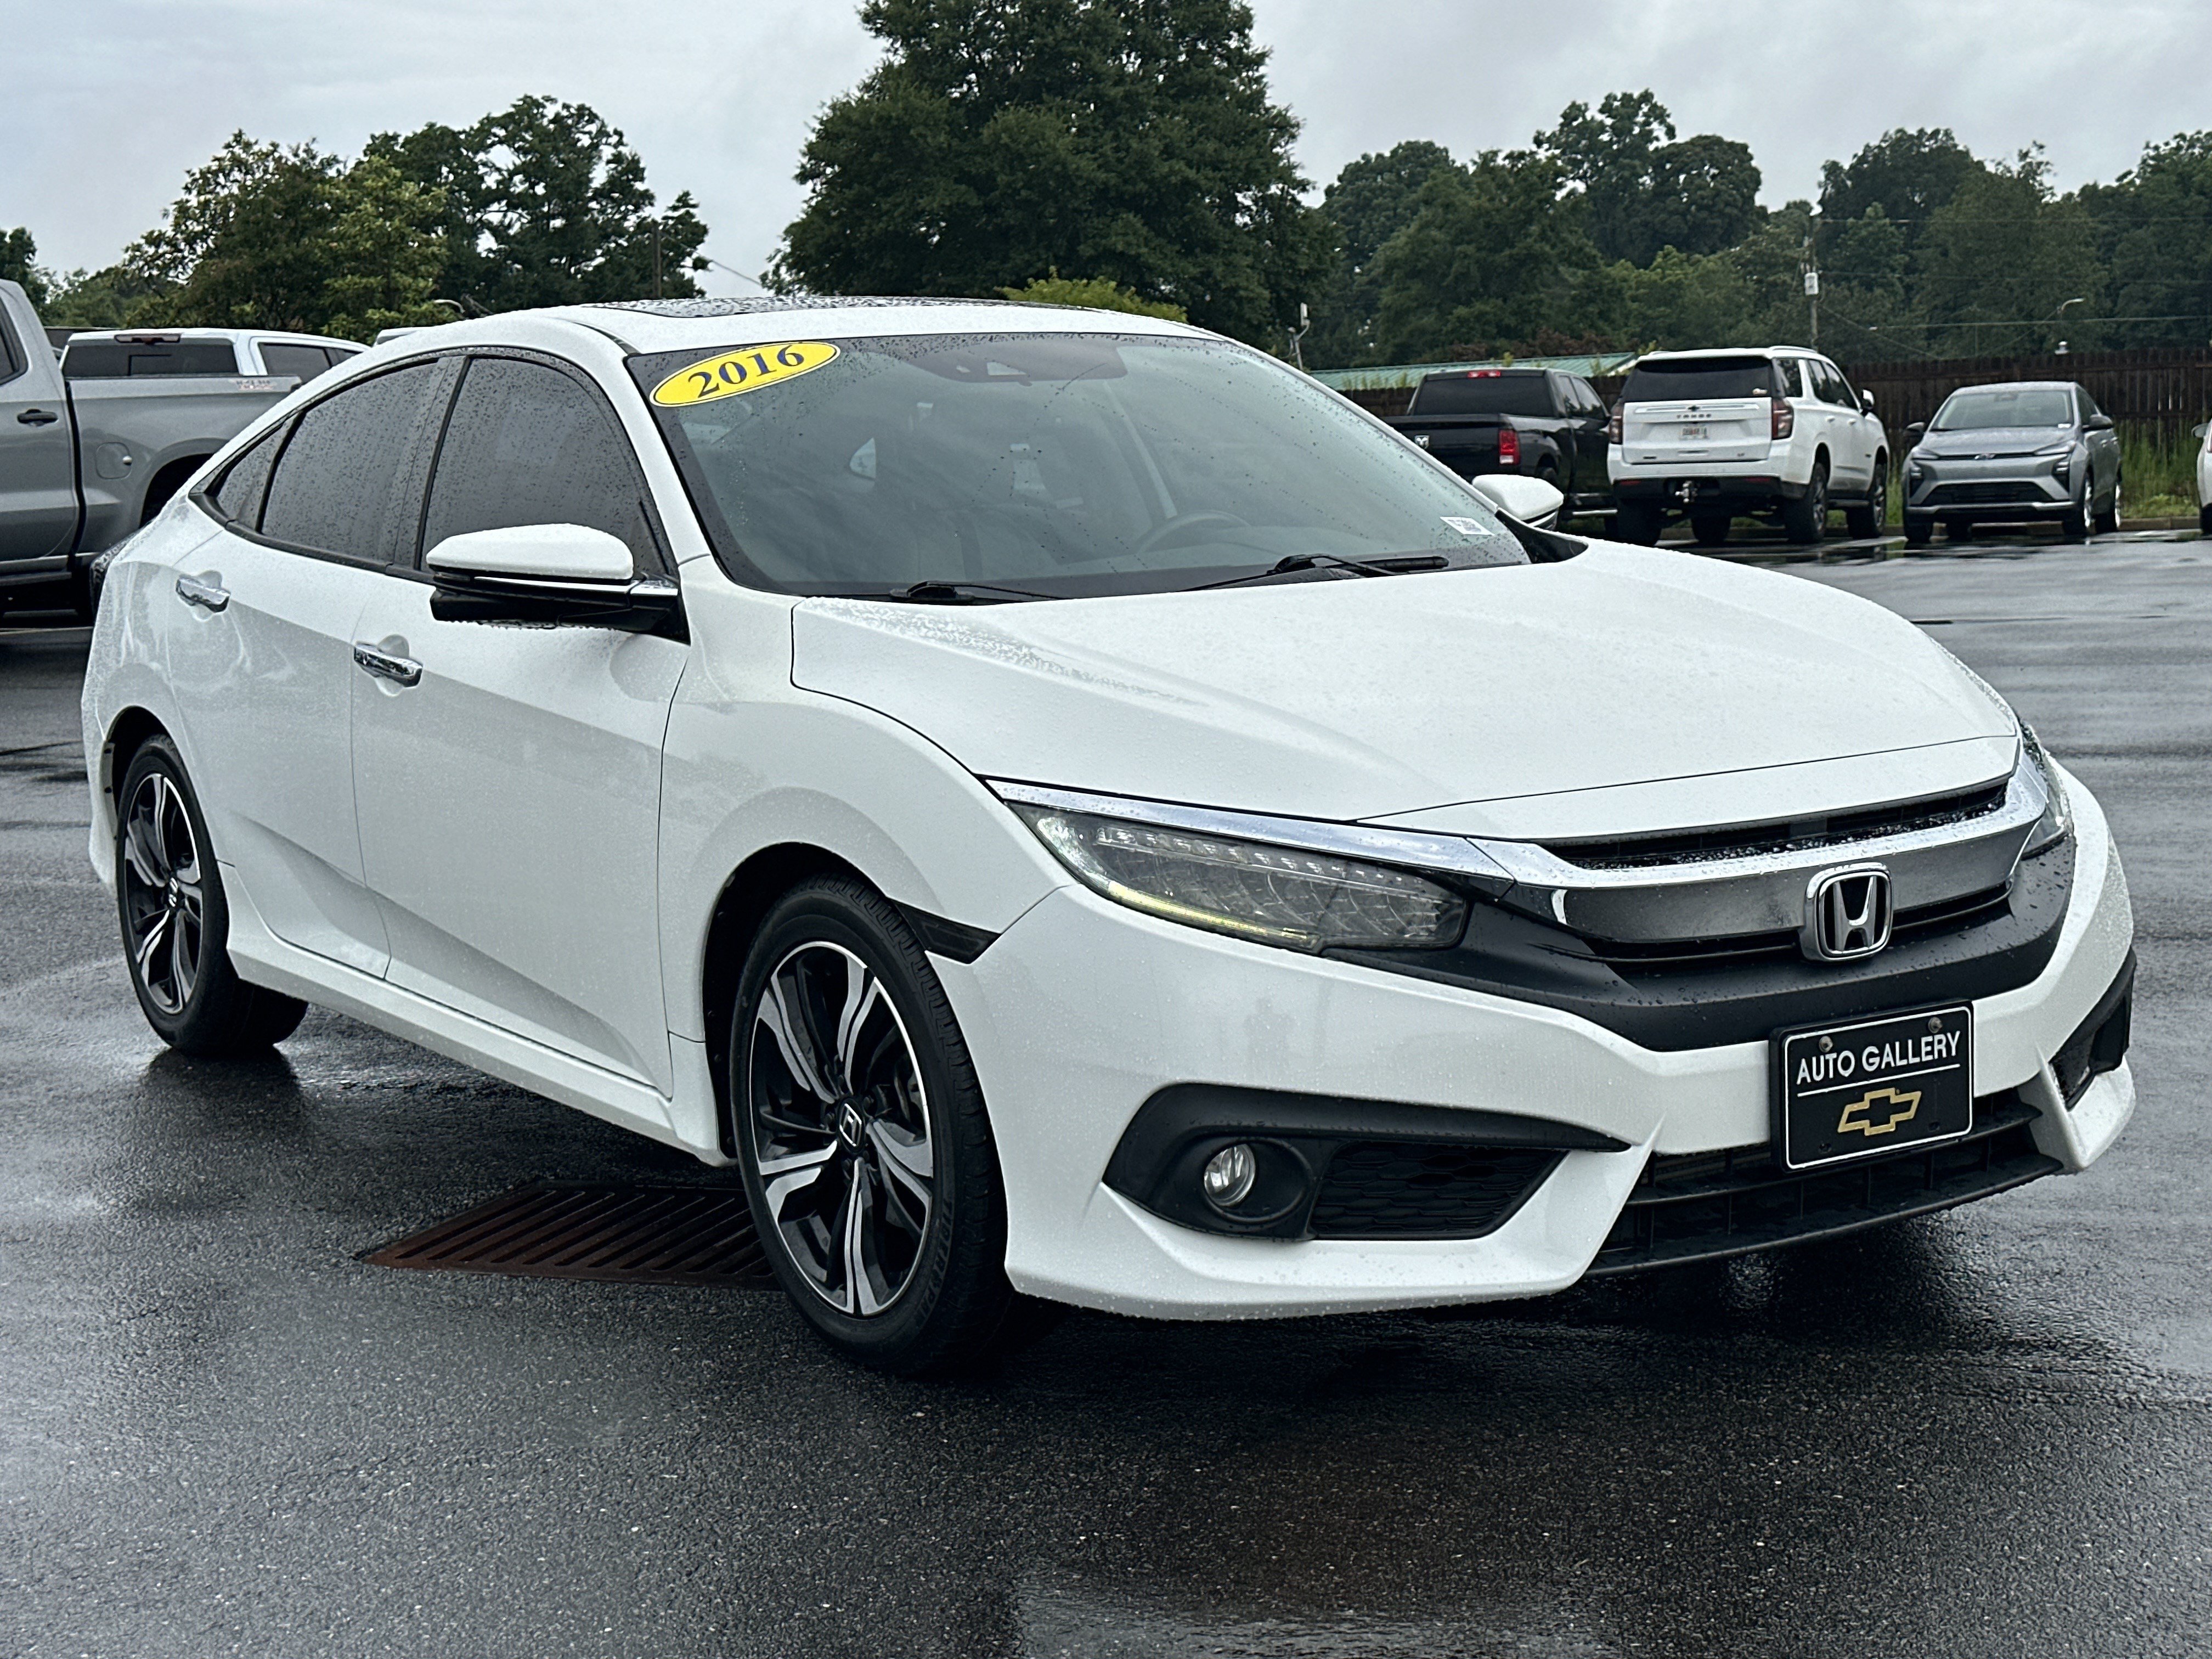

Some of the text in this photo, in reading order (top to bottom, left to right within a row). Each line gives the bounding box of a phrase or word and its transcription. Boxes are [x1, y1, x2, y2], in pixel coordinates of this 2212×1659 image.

[688, 345, 805, 398] 2016
[1796, 1030, 1961, 1085] AUTO GALLERY
